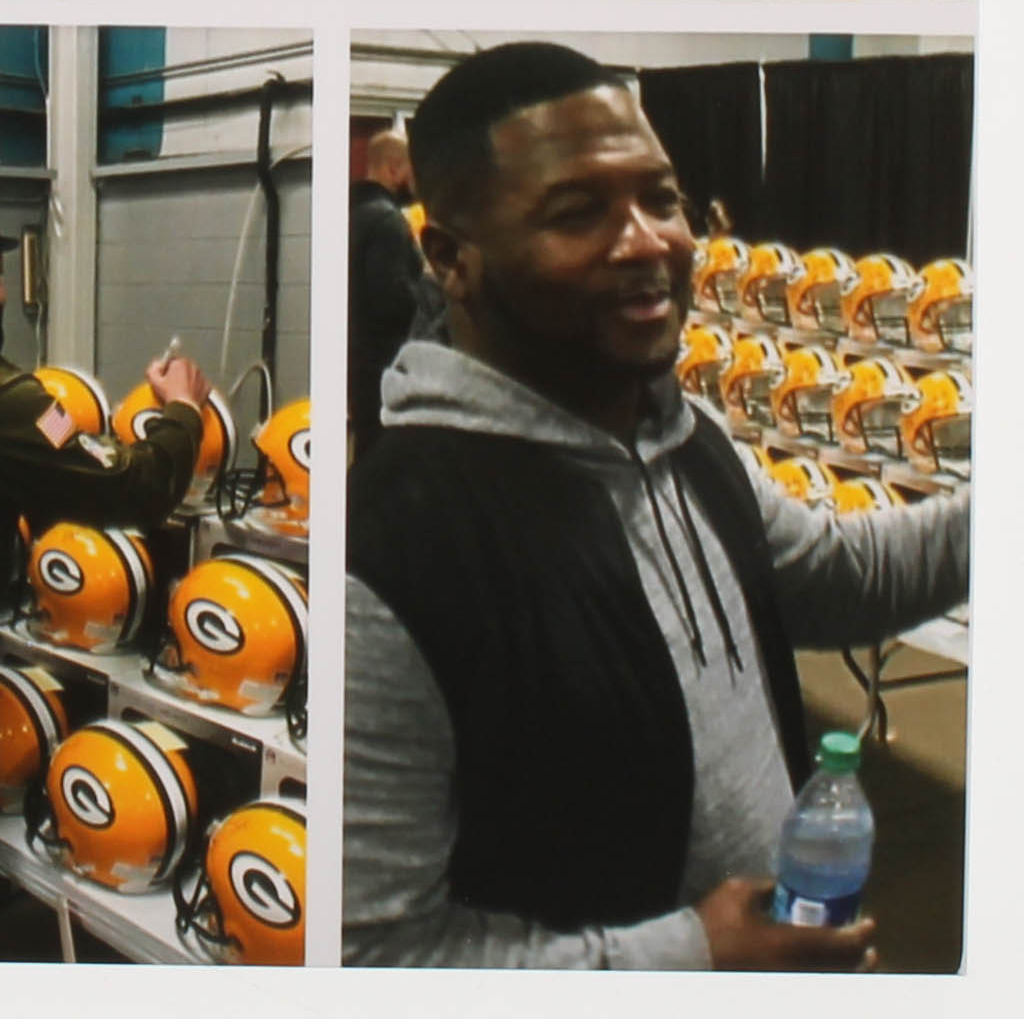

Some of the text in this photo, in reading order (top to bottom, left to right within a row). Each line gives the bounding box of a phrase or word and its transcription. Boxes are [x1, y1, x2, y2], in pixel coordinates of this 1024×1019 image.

[40, 550, 81, 592] G
[187, 600, 240, 652] G
[64, 767, 111, 825] G
[231, 853, 295, 924] G
